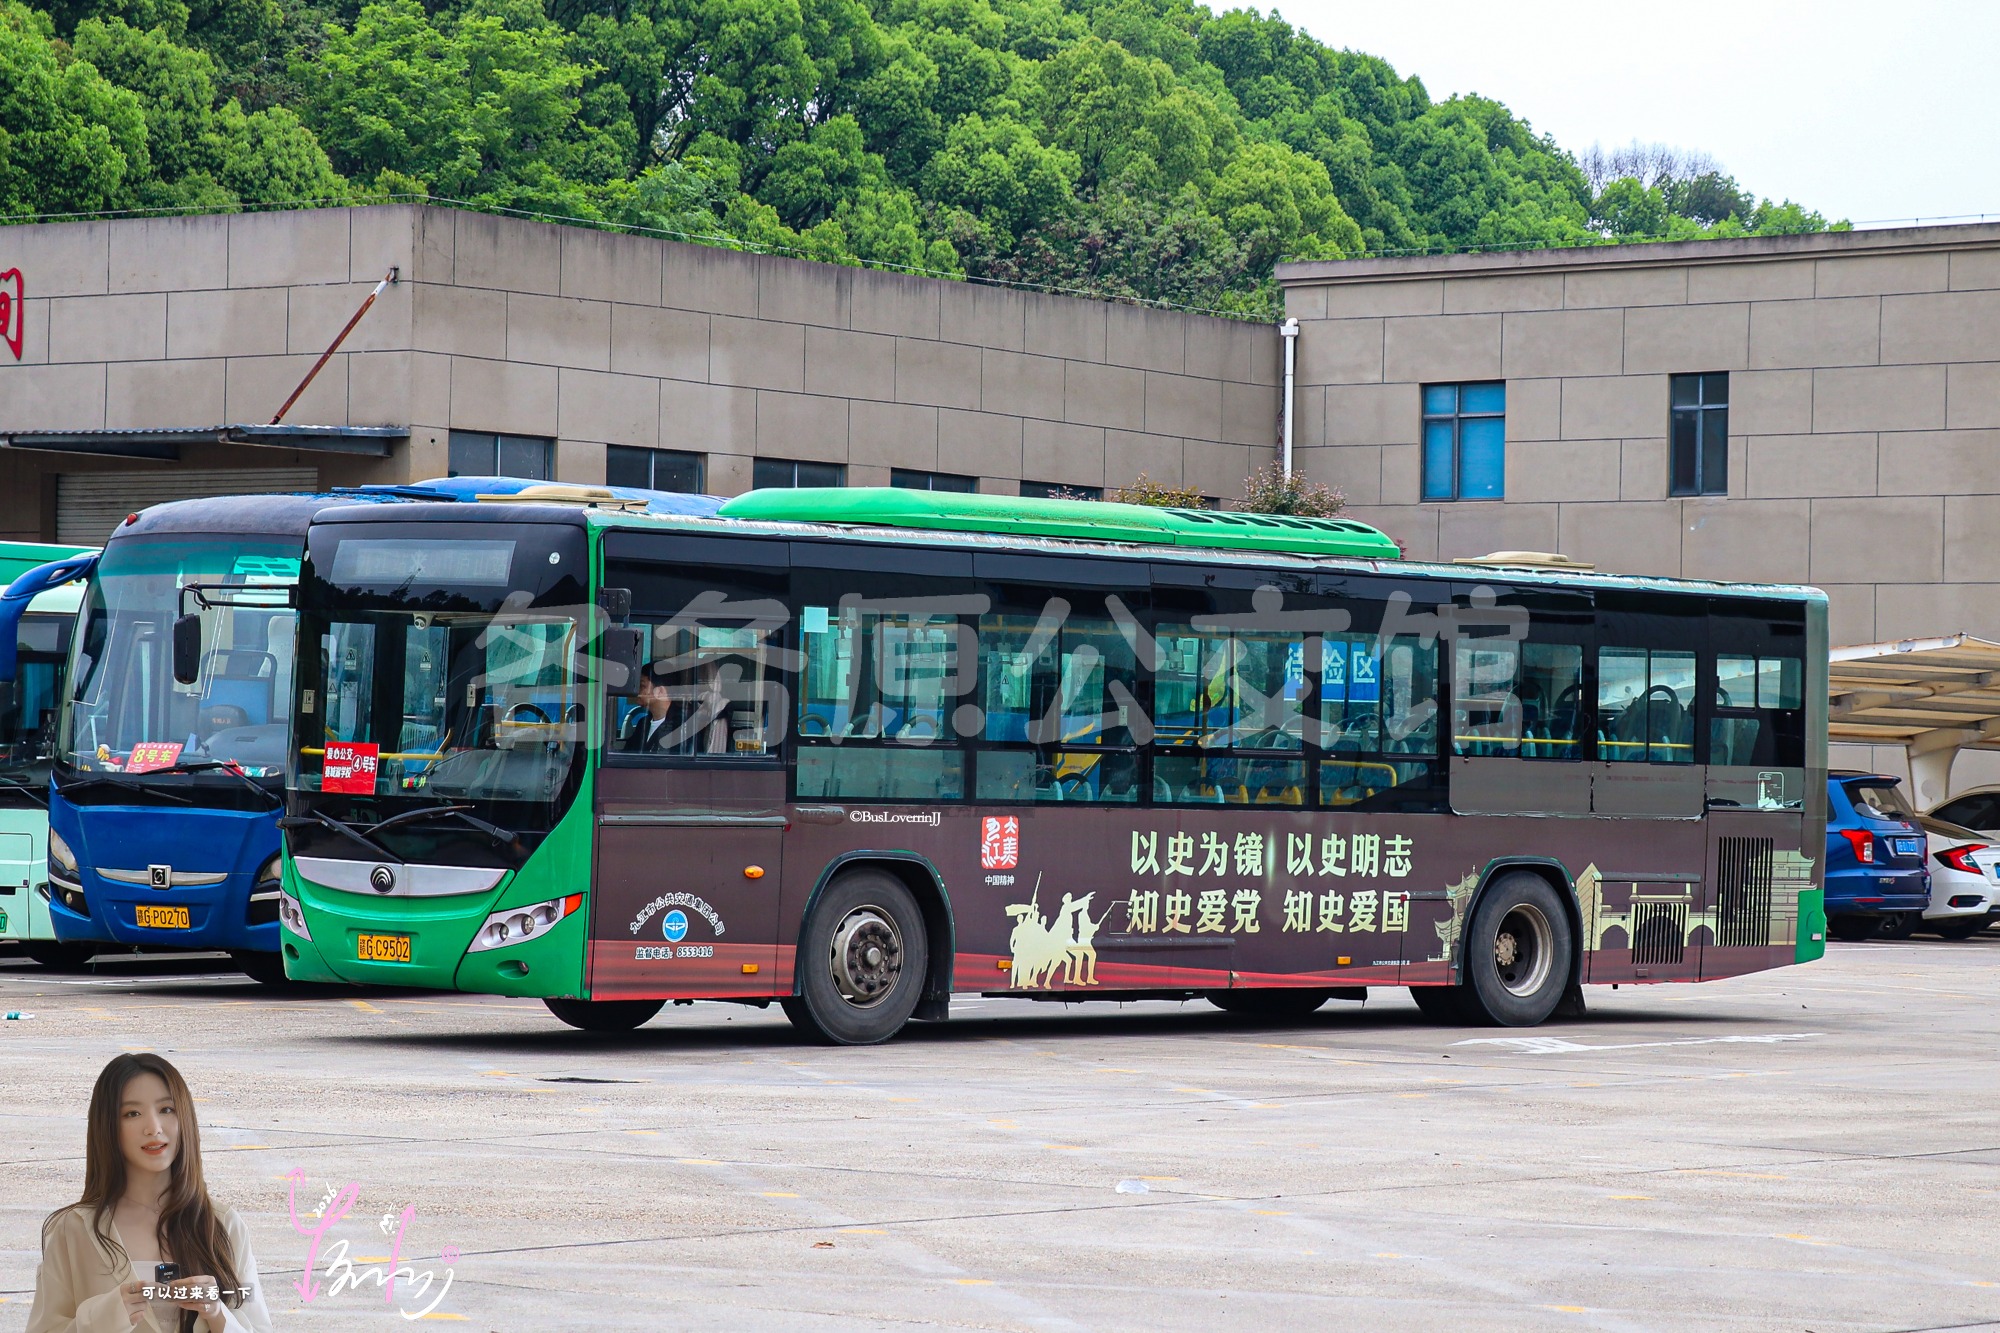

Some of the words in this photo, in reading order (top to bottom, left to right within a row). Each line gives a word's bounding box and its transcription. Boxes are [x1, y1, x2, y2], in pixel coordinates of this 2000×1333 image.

[133, 748, 173, 763] 8号车
[1130, 830, 1264, 877] 以史为镜
[1286, 832, 1413, 878] 以史明志
[1126, 888, 1262, 934] 知史爱党
[1282, 888, 1410, 934] 知史爱国
